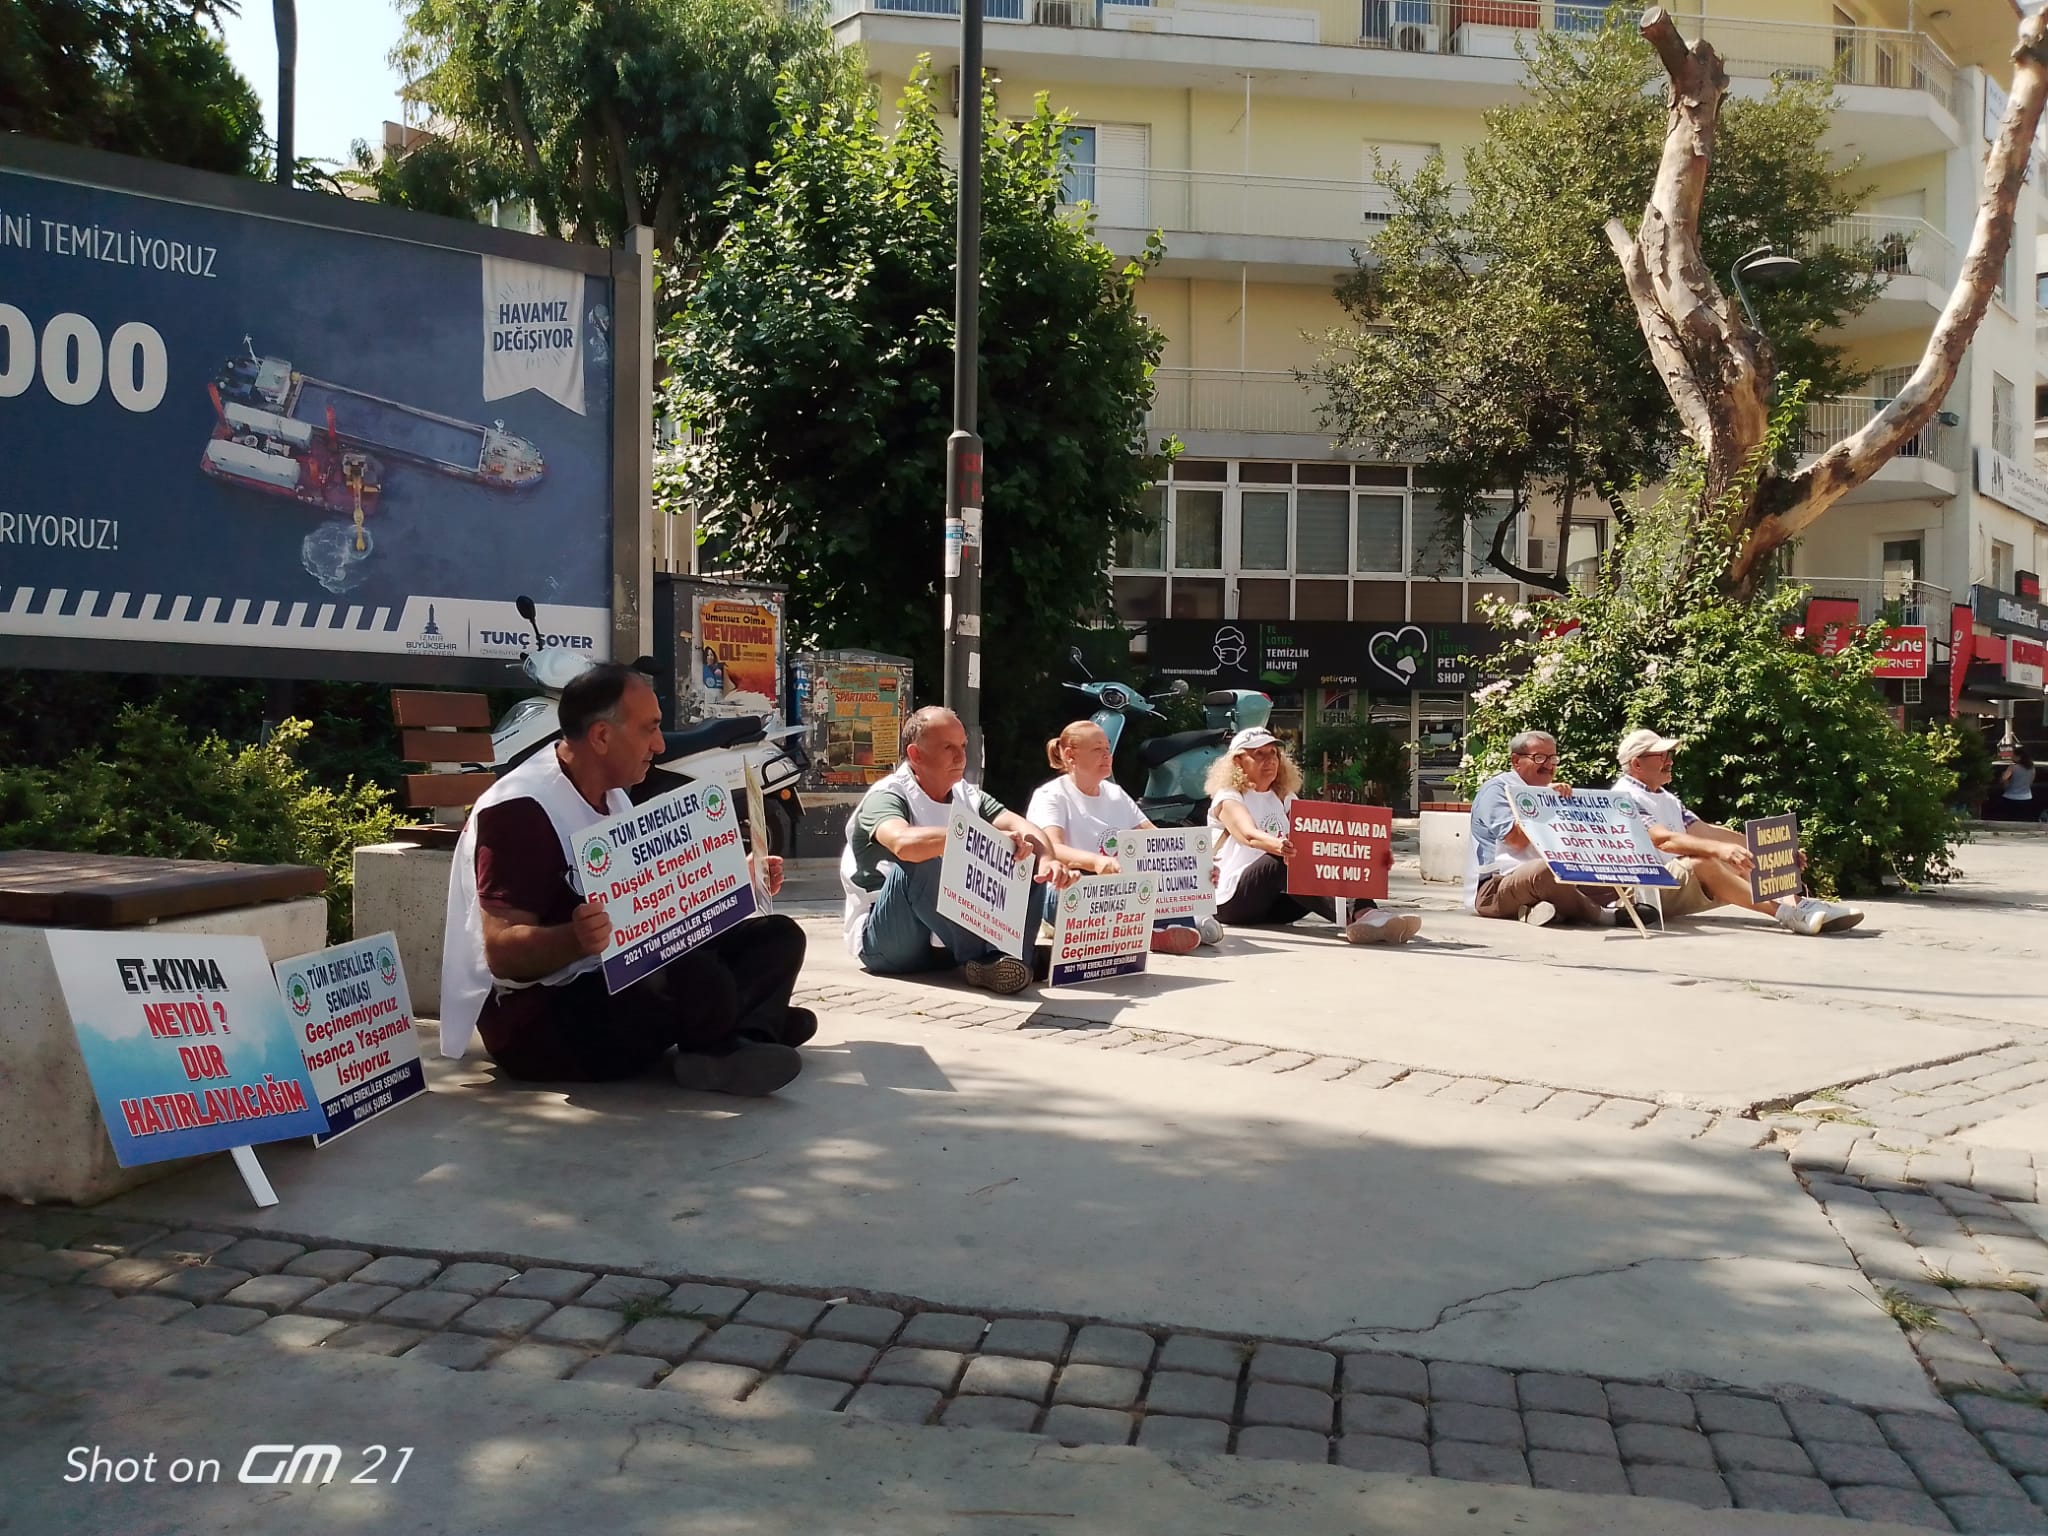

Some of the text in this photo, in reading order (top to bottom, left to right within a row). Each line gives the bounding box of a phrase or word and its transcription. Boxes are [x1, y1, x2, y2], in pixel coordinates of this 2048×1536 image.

[41, 220, 217, 278] TEMİZLİYORUZ
[500, 302, 568, 324] HAVAMIZ
[493, 327, 574, 352] DEĞİŞİYOR
[0, 303, 168, 413] 000
[0, 511, 118, 551] RIYORUZ!
[743, 616, 766, 625] Olma
[480, 631, 593, 649] TUNÇ SOYER
[1266, 648, 1309, 658] TEMİZLİK
[1437, 657, 1456, 668] PET
[1886, 658, 1921, 668] RNET
[1437, 672, 1465, 683] SHOP
[1536, 792, 1612, 809] TÜM EMEKLİLER
[608, 821, 637, 848] TÜM
[637, 793, 700, 837] EMEKLİLER
[1555, 808, 1607, 823] SENDİKASI
[1294, 817, 1387, 839] SARAYA VAR DA
[1549, 823, 1629, 834] YILDA EN AZ
[1757, 824, 1791, 846] İNSANCA
[632, 822, 692, 866] SENDİKASI
[965, 825, 1016, 880] EMEKLİLER
[1146, 833, 1185, 853] DEMOKRASİ
[1312, 841, 1371, 860] EMEKLİYE
[588, 827, 738, 906] En Düşük Emekli Maaşı
[1137, 854, 1197, 872] MÜCADELESİNDEN
[1544, 849, 1590, 863] EMEKLİ
[1757, 848, 1794, 872] YAŞAMAK
[1166, 875, 1198, 892] OLUNMAZ
[1315, 864, 1371, 882] YOK MU ?
[1758, 872, 1797, 896] İSTİYORUZ
[632, 860, 714, 914] Asgari Ücret
[965, 861, 1007, 912] BİRLEŞİN
[1082, 880, 1137, 899] TÜM EMEKLİLER
[614, 873, 737, 947] Düzeyine Çıkarılsın
[1090, 898, 1126, 914] SENDİKASI
[1156, 895, 1179, 904] KLİLER
[624, 895, 738, 966] 2021 TÜM EMEKLİLER SENDİKASI
[960, 911, 981, 929] KONAK
[1066, 915, 1105, 930] Market
[1115, 912, 1145, 924] Pazar
[660, 921, 713, 961] KONAK ŞUBESİ
[1064, 924, 1143, 944] Belimizi Büktü
[1061, 939, 1143, 960] Geçinemiyoruz
[116, 958, 228, 992] ET-KIYMA
[306, 963, 329, 991] TÜM
[330, 951, 377, 984] EMEKLİLER
[326, 979, 372, 1013] SENDİKASI
[143, 993, 214, 1038] NEYDİ
[305, 996, 398, 1044] Geçinemiyoruz
[356, 1013, 411, 1050] Yaşamak
[178, 1044, 230, 1080] DUR
[336, 1050, 391, 1086] İstiyoruz
[120, 1073, 308, 1137] HATIRLAYACAĞIM
